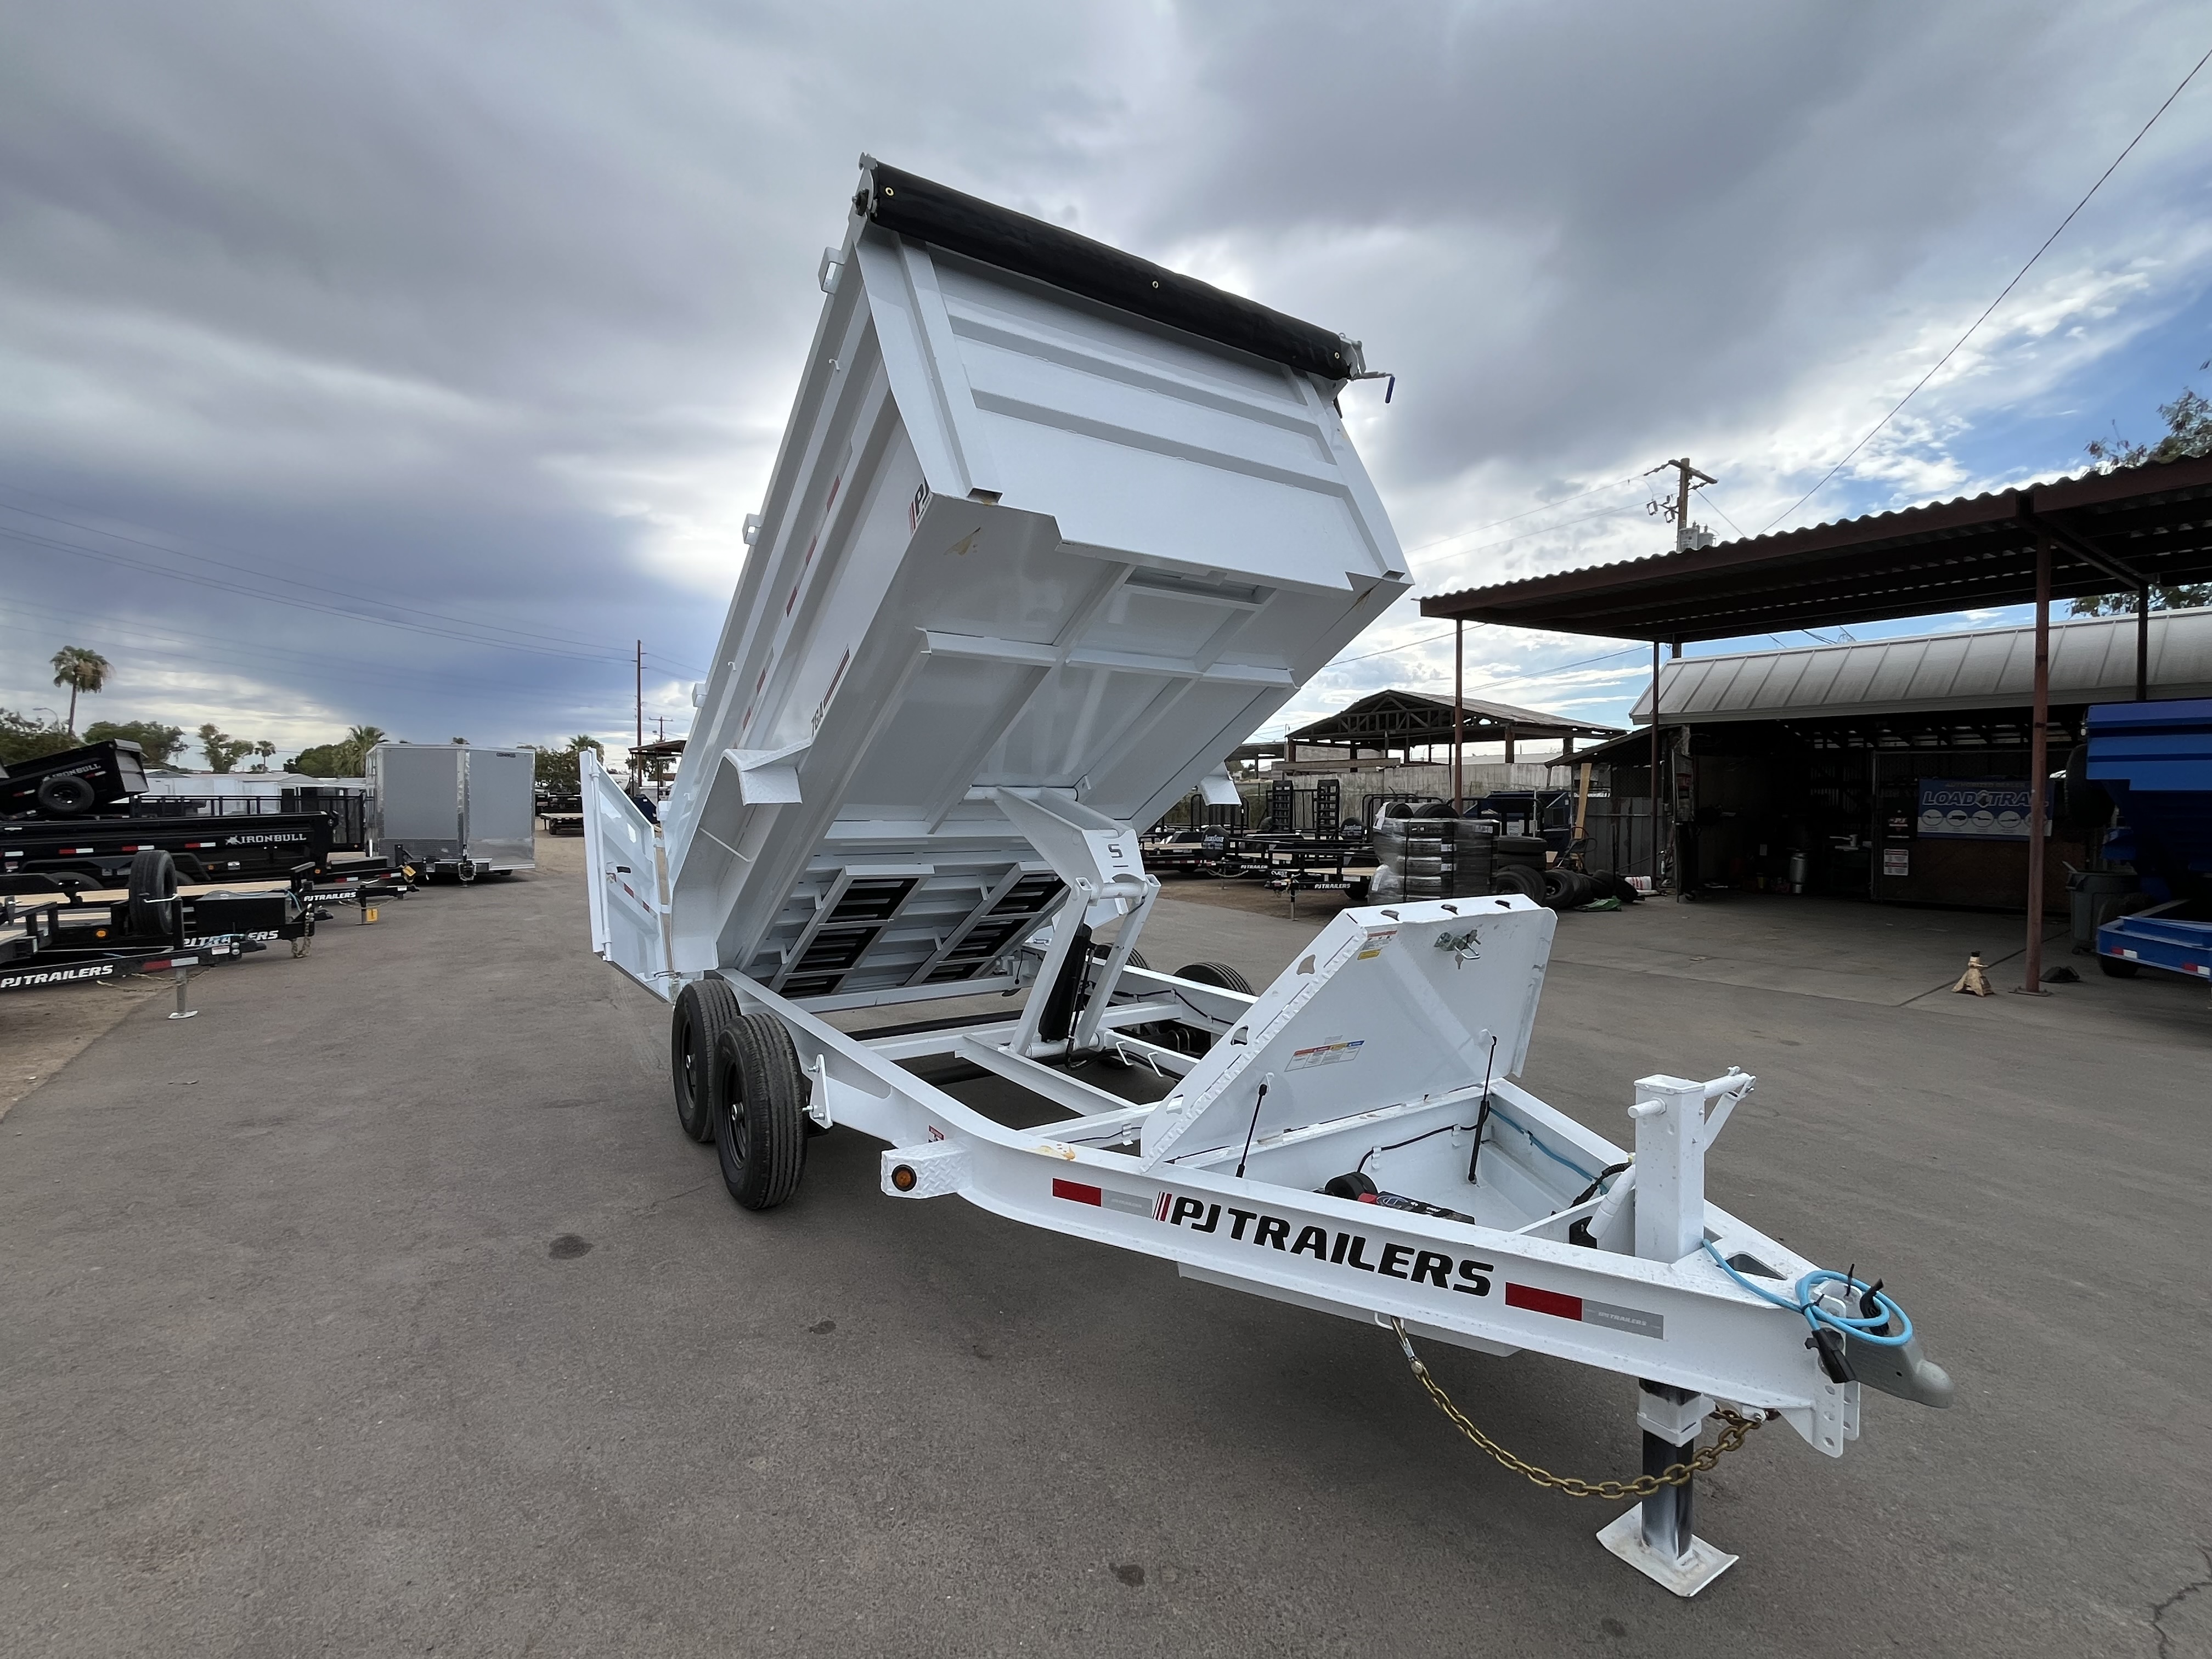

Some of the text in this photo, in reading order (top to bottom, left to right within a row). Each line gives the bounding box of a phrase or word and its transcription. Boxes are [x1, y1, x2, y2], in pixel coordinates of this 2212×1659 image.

[1922, 791, 2049, 807] LOAD TRA
[241, 833, 307, 844] IRONBULL
[198, 930, 279, 947] TRAERS
